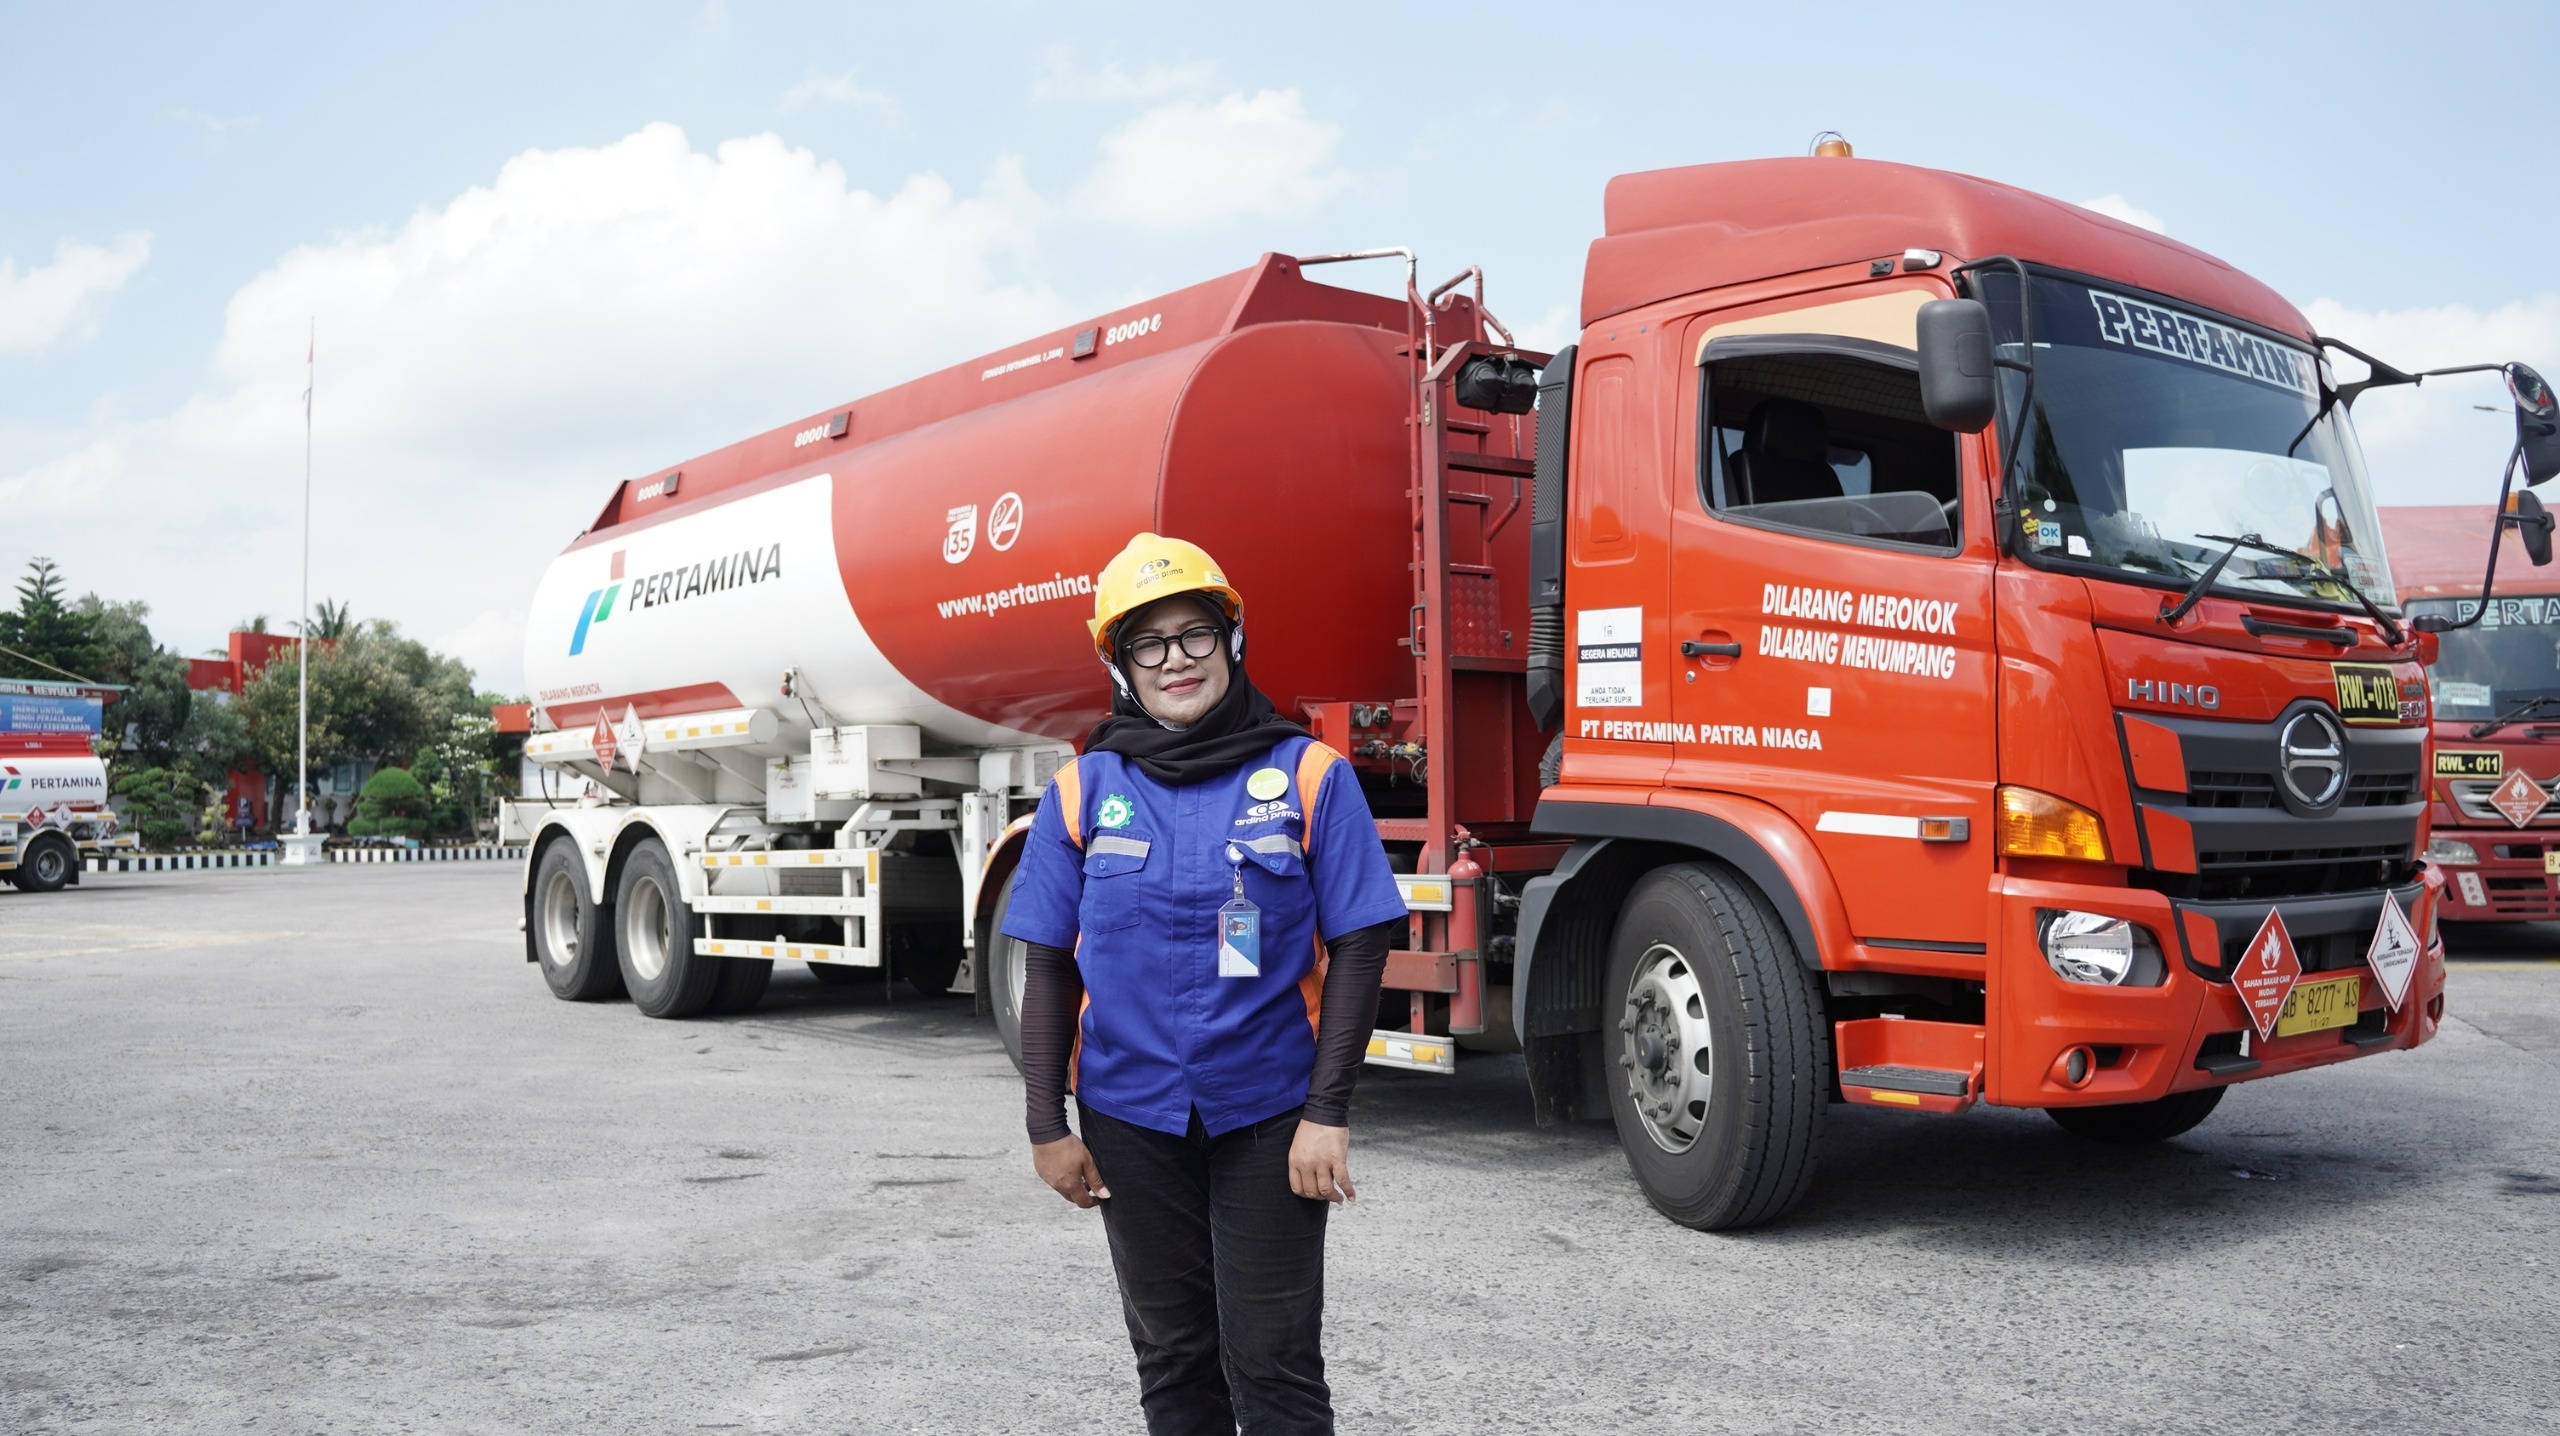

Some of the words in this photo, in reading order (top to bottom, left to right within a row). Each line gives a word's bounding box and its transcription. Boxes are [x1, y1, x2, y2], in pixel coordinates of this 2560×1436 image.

[2088, 289, 2321, 400] PERTAMINA
[2041, 527, 2058, 537] OK
[629, 543, 781, 611] PERTAMINA
[1136, 573, 1160, 589] ardina
[1161, 568, 1184, 578] prima
[1762, 583, 1853, 624] DILARANG
[1856, 593, 1959, 635] MEROKOK
[1580, 649, 1606, 660] SEGERA
[1606, 647, 1638, 659] MENJAUH
[1759, 625, 1839, 665] DILARANG
[1840, 635, 1956, 680] MENUMPANG
[539, 687, 571, 701] DILARANG
[570, 682, 602, 697] MEROKOK
[1591, 687, 1606, 695] ANDA
[1608, 686, 1626, 694] TIDAK
[2128, 677, 2220, 710] HINO
[2339, 674, 2396, 711] RWL-018
[1585, 696, 1612, 704] TERLIHAT
[1580, 719, 1600, 739] PT
[1603, 720, 1696, 743] PERTAMINA
[1700, 724, 1757, 746] PATRA
[1762, 727, 1823, 750] NIAGA
[2437, 756, 2466, 771] RWL
[2476, 756, 2498, 772] 011
[31, 777, 102, 789] PERTAMINA
[1234, 815, 1269, 826] ardina
[1270, 810, 1301, 820] prima
[2515, 813, 2523, 822] 3
[2243, 978, 2263, 988] BAHAN
[2263, 976, 2279, 987] BAKAR
[2280, 975, 2291, 983] CAIR
[2258, 987, 2277, 997] MUDAH
[2282, 990, 2298, 1020] AB
[2307, 984, 2336, 1015] 8277
[2344, 981, 2359, 1009] AS
[2255, 997, 2279, 1008] TERBAKAR
[2261, 1012, 2270, 1033] 3
